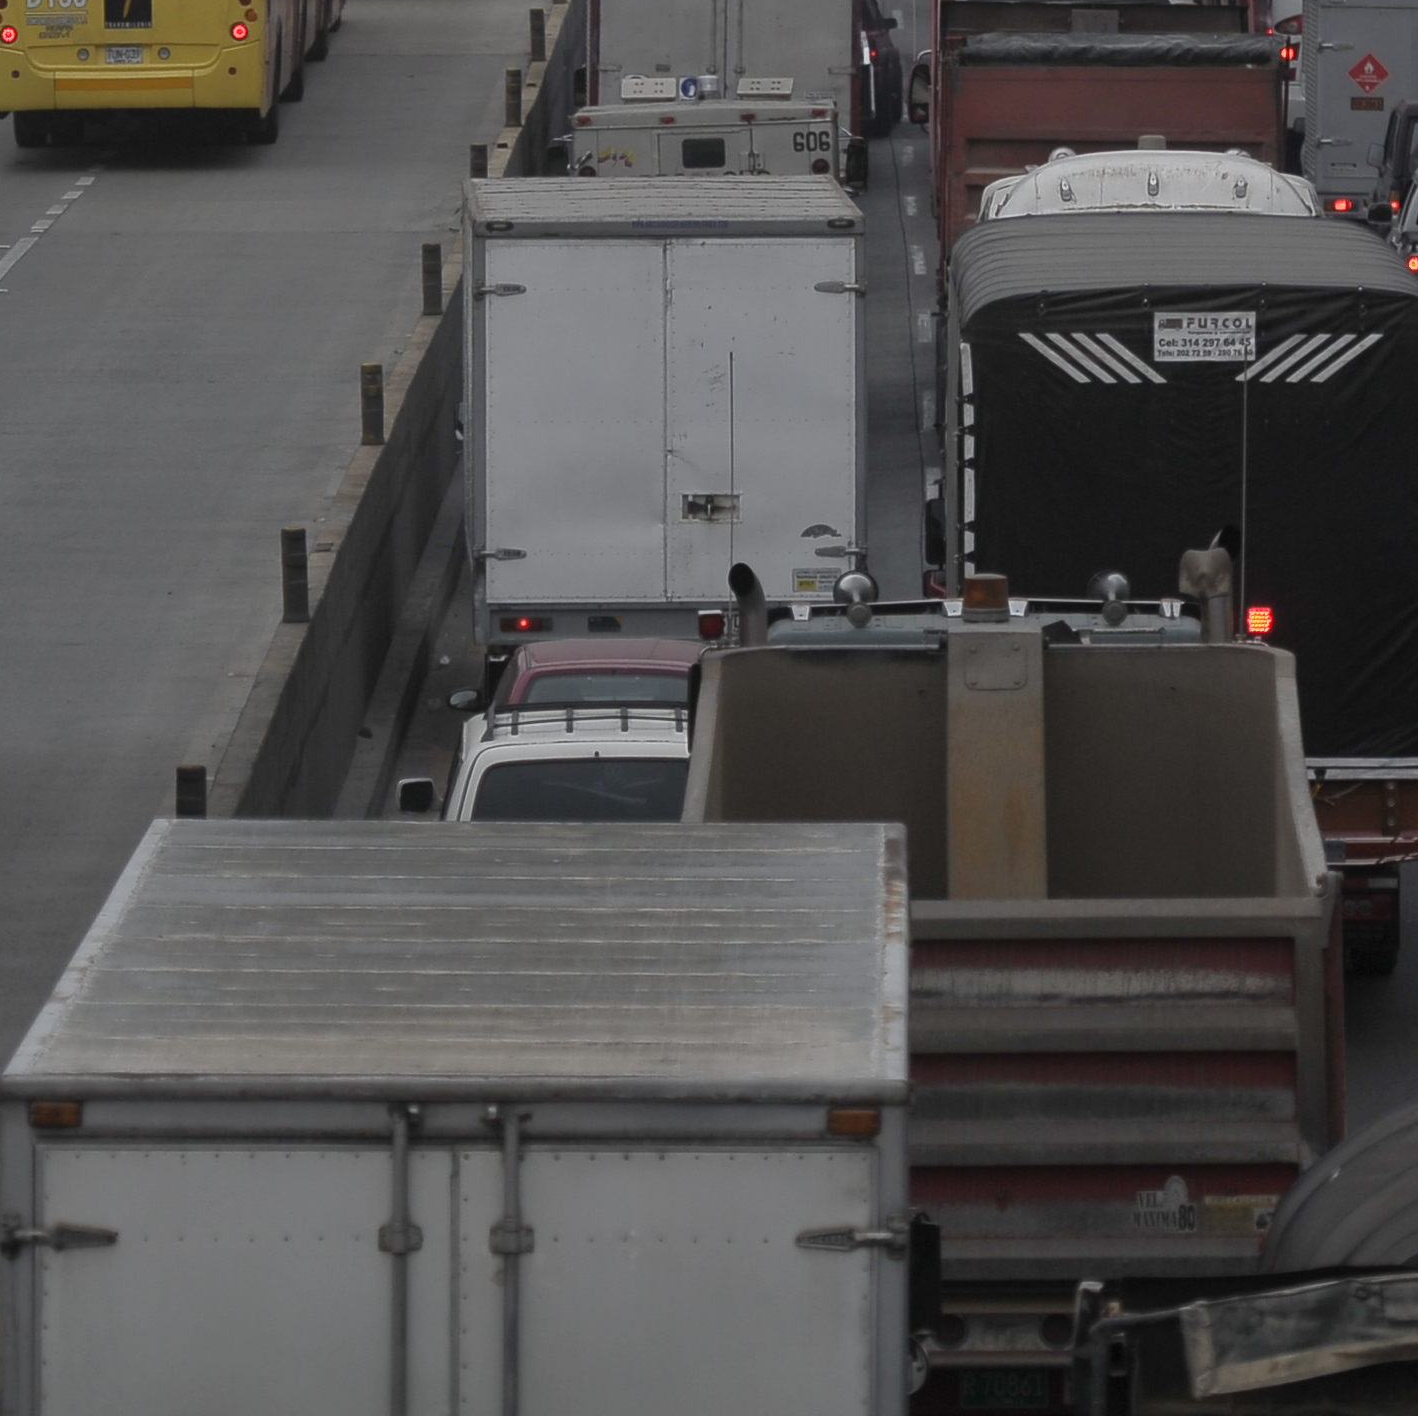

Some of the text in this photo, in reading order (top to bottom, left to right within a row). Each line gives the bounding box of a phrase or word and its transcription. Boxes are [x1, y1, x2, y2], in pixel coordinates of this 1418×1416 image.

[792, 130, 831, 153] 606
[1186, 316, 1254, 329] FURCOL
[1158, 338, 1179, 347] Cel:
[1181, 338, 1200, 347] 314
[1202, 338, 1221, 347] 297
[1223, 338, 1236, 347] 64
[1132, 1204, 1196, 1231] MAXIMA 80
